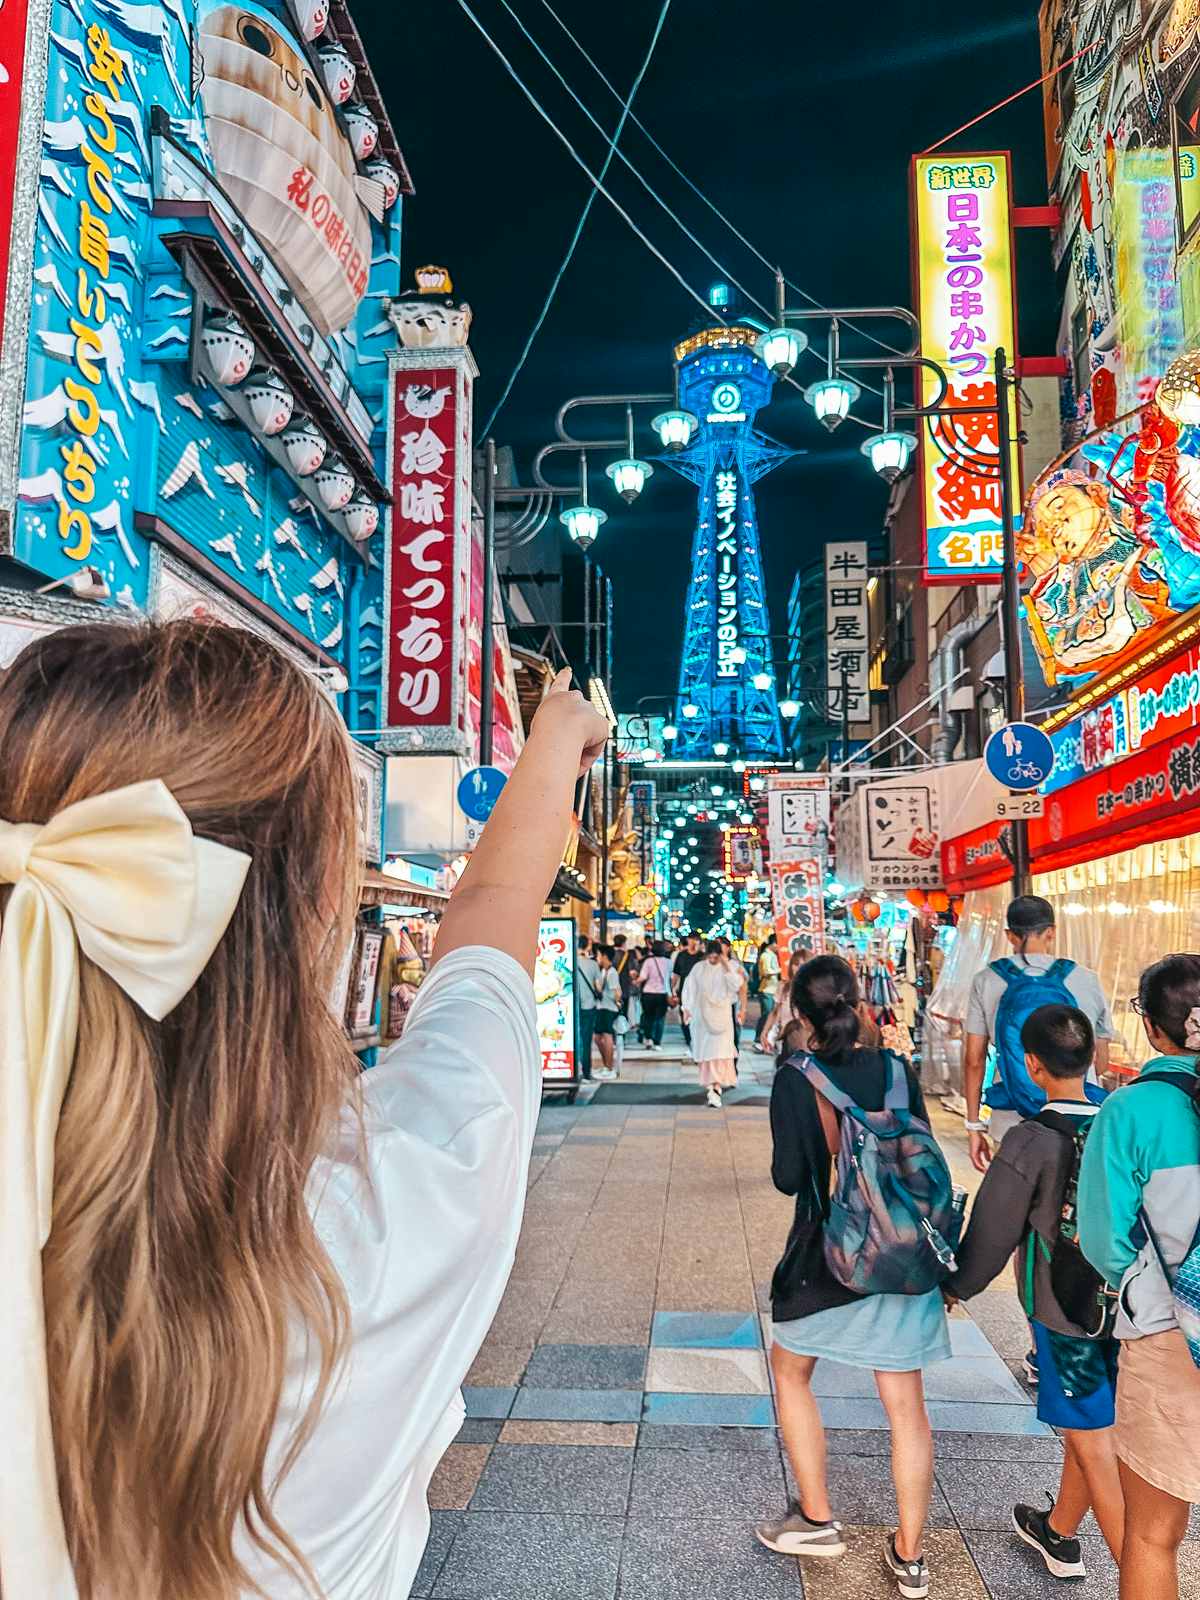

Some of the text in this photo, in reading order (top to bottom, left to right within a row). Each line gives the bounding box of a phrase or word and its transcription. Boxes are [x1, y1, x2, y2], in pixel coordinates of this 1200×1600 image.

[929, 165, 994, 190] 新世界
[946, 193, 988, 377] 日本一の串かつ
[397, 428, 447, 716] 珍味てっちり
[716, 471, 738, 677] 社会イノベーションの日立
[828, 551, 868, 711] 半田屋酒店
[1098, 773, 1165, 817] 日本一の串かつ
